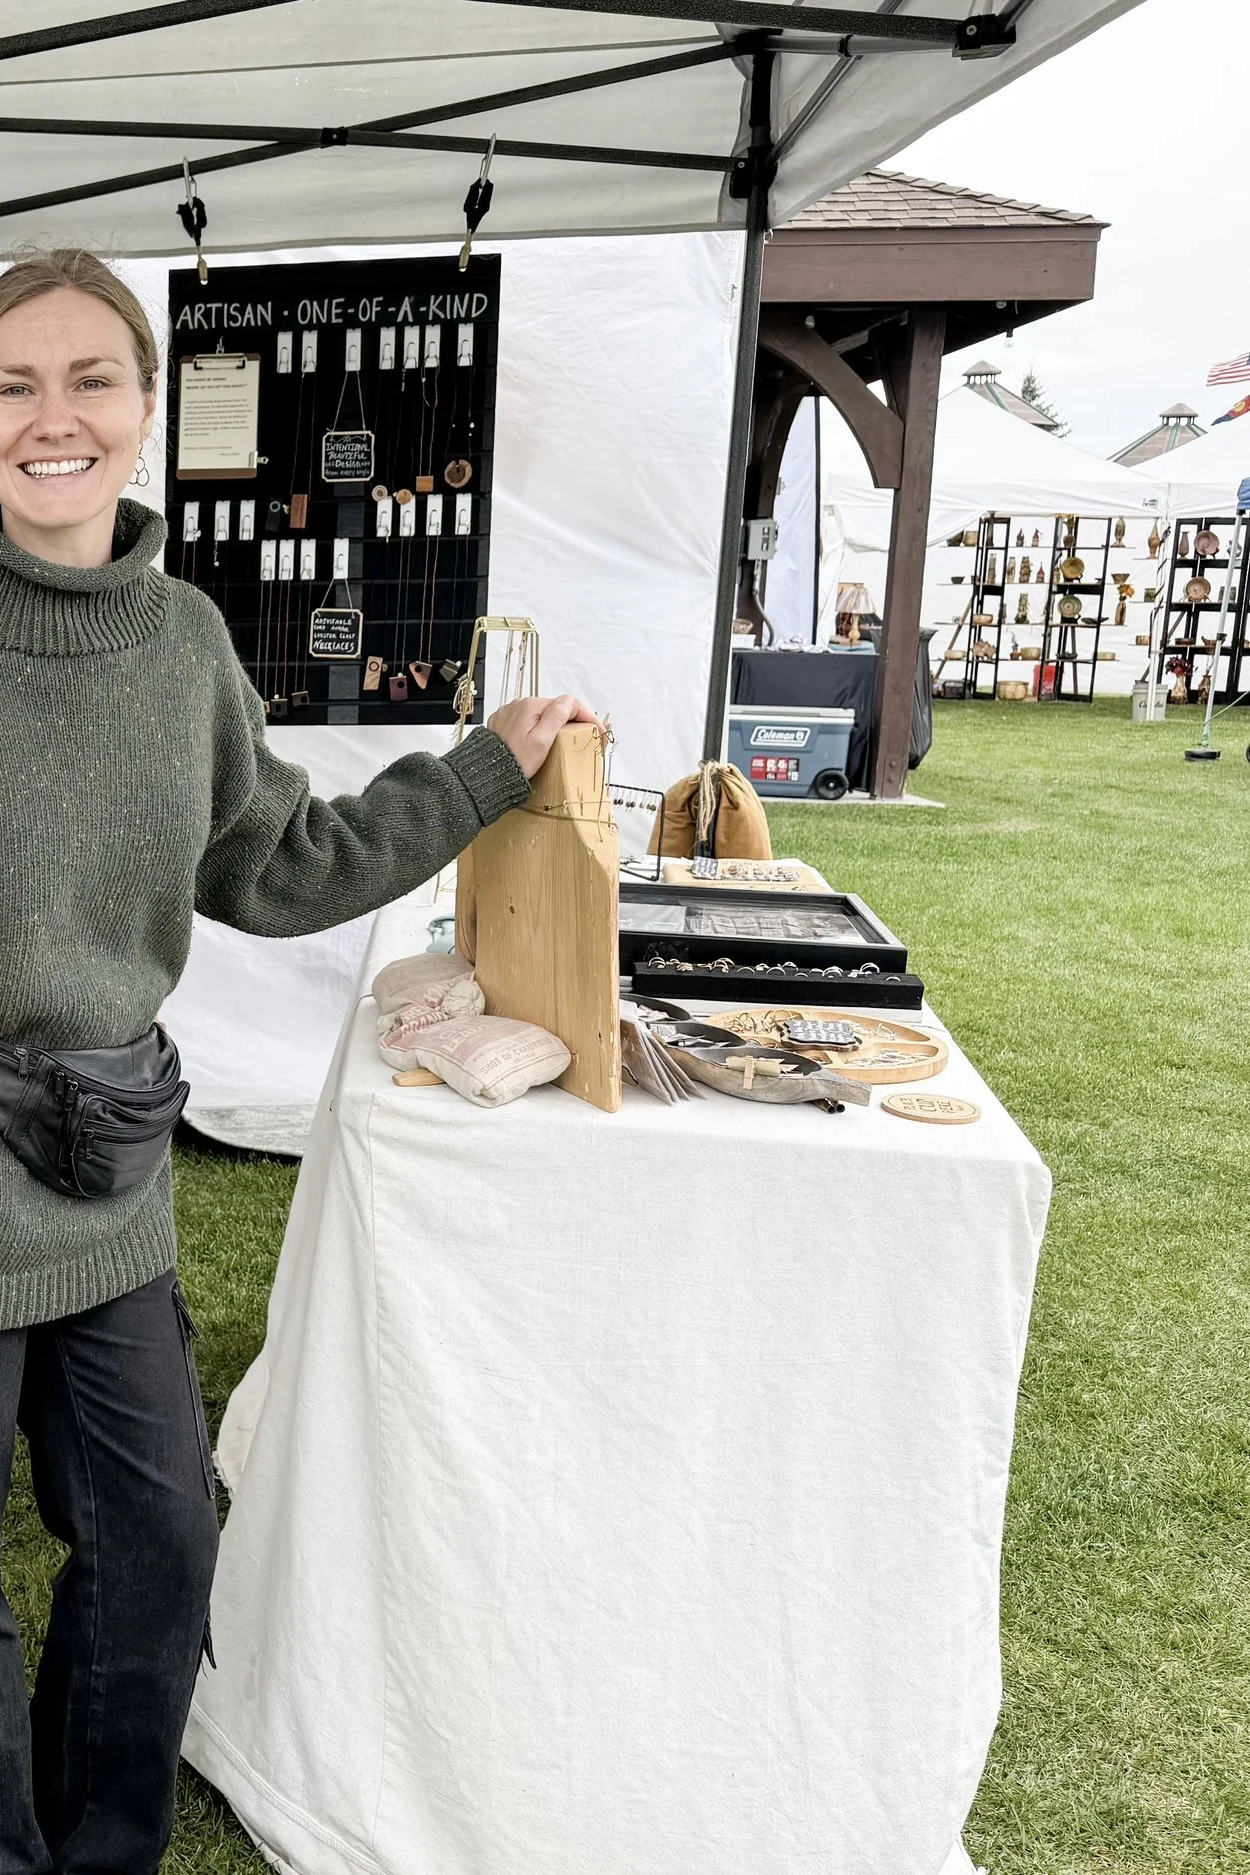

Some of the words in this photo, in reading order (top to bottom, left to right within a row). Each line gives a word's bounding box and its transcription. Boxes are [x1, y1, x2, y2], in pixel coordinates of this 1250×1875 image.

[175, 301, 272, 330] ARTISAN
[313, 639, 355, 653] NECKLACES
[757, 729, 795, 740] Coleman
[479, 1058, 502, 1074] SHOT
